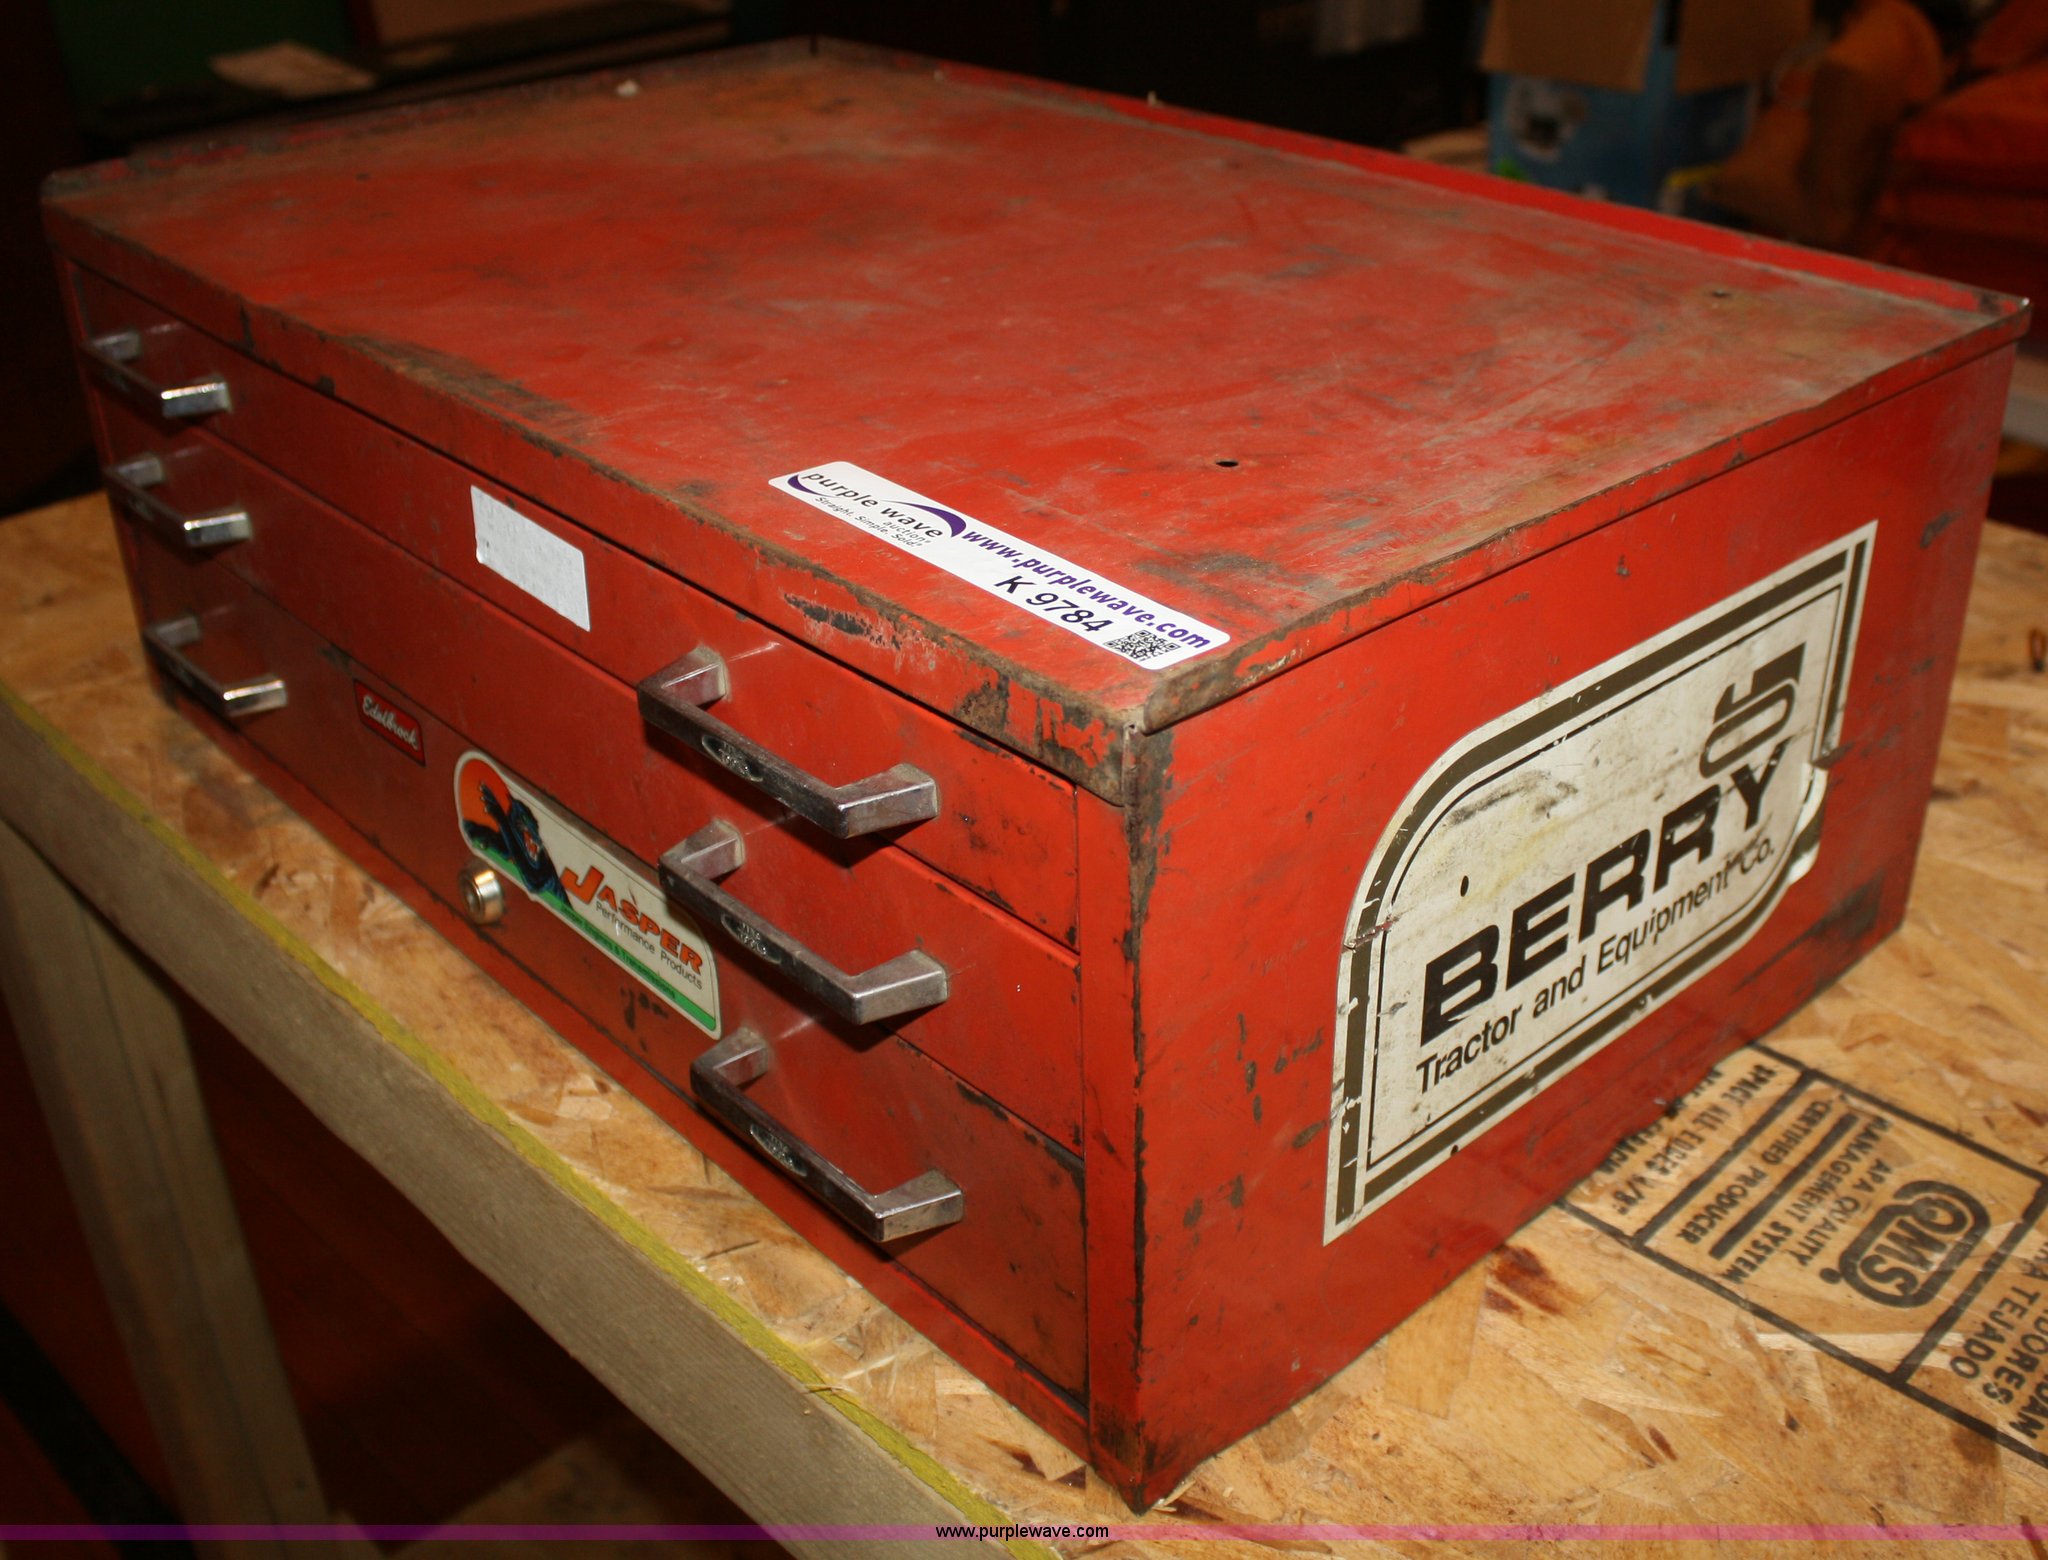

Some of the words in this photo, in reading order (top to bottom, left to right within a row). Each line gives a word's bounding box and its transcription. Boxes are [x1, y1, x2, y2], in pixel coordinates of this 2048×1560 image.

[801, 473, 878, 507] purple
[880, 507, 943, 538] wave
[962, 531, 1211, 649] www.purplewave.com
[993, 575, 1037, 594] K
[1025, 592, 1114, 632] 9784
[560, 865, 703, 976] JASPER
[1420, 734, 1796, 1048] BERRY
[595, 901, 655, 954] Performance
[660, 951, 702, 990] Products
[1416, 1004, 1523, 1095] Tractor
[1532, 954, 1587, 1019] and
[1598, 857, 1732, 975] Equipment
[1741, 838, 1774, 875] Co.
[1761, 1101, 1832, 1165] CERTIFIED
[1785, 1115, 1892, 1222] MANAGEMENT
[1853, 1159, 1892, 1192] APA
[1677, 1165, 1767, 1244] PRODUCER
[1789, 1196, 1861, 1266] QUALITY
[1854, 1193, 1972, 1303] QMS
[1722, 1220, 1792, 1284] SYSTEM
[1950, 1286, 2041, 1379] TEJADO
